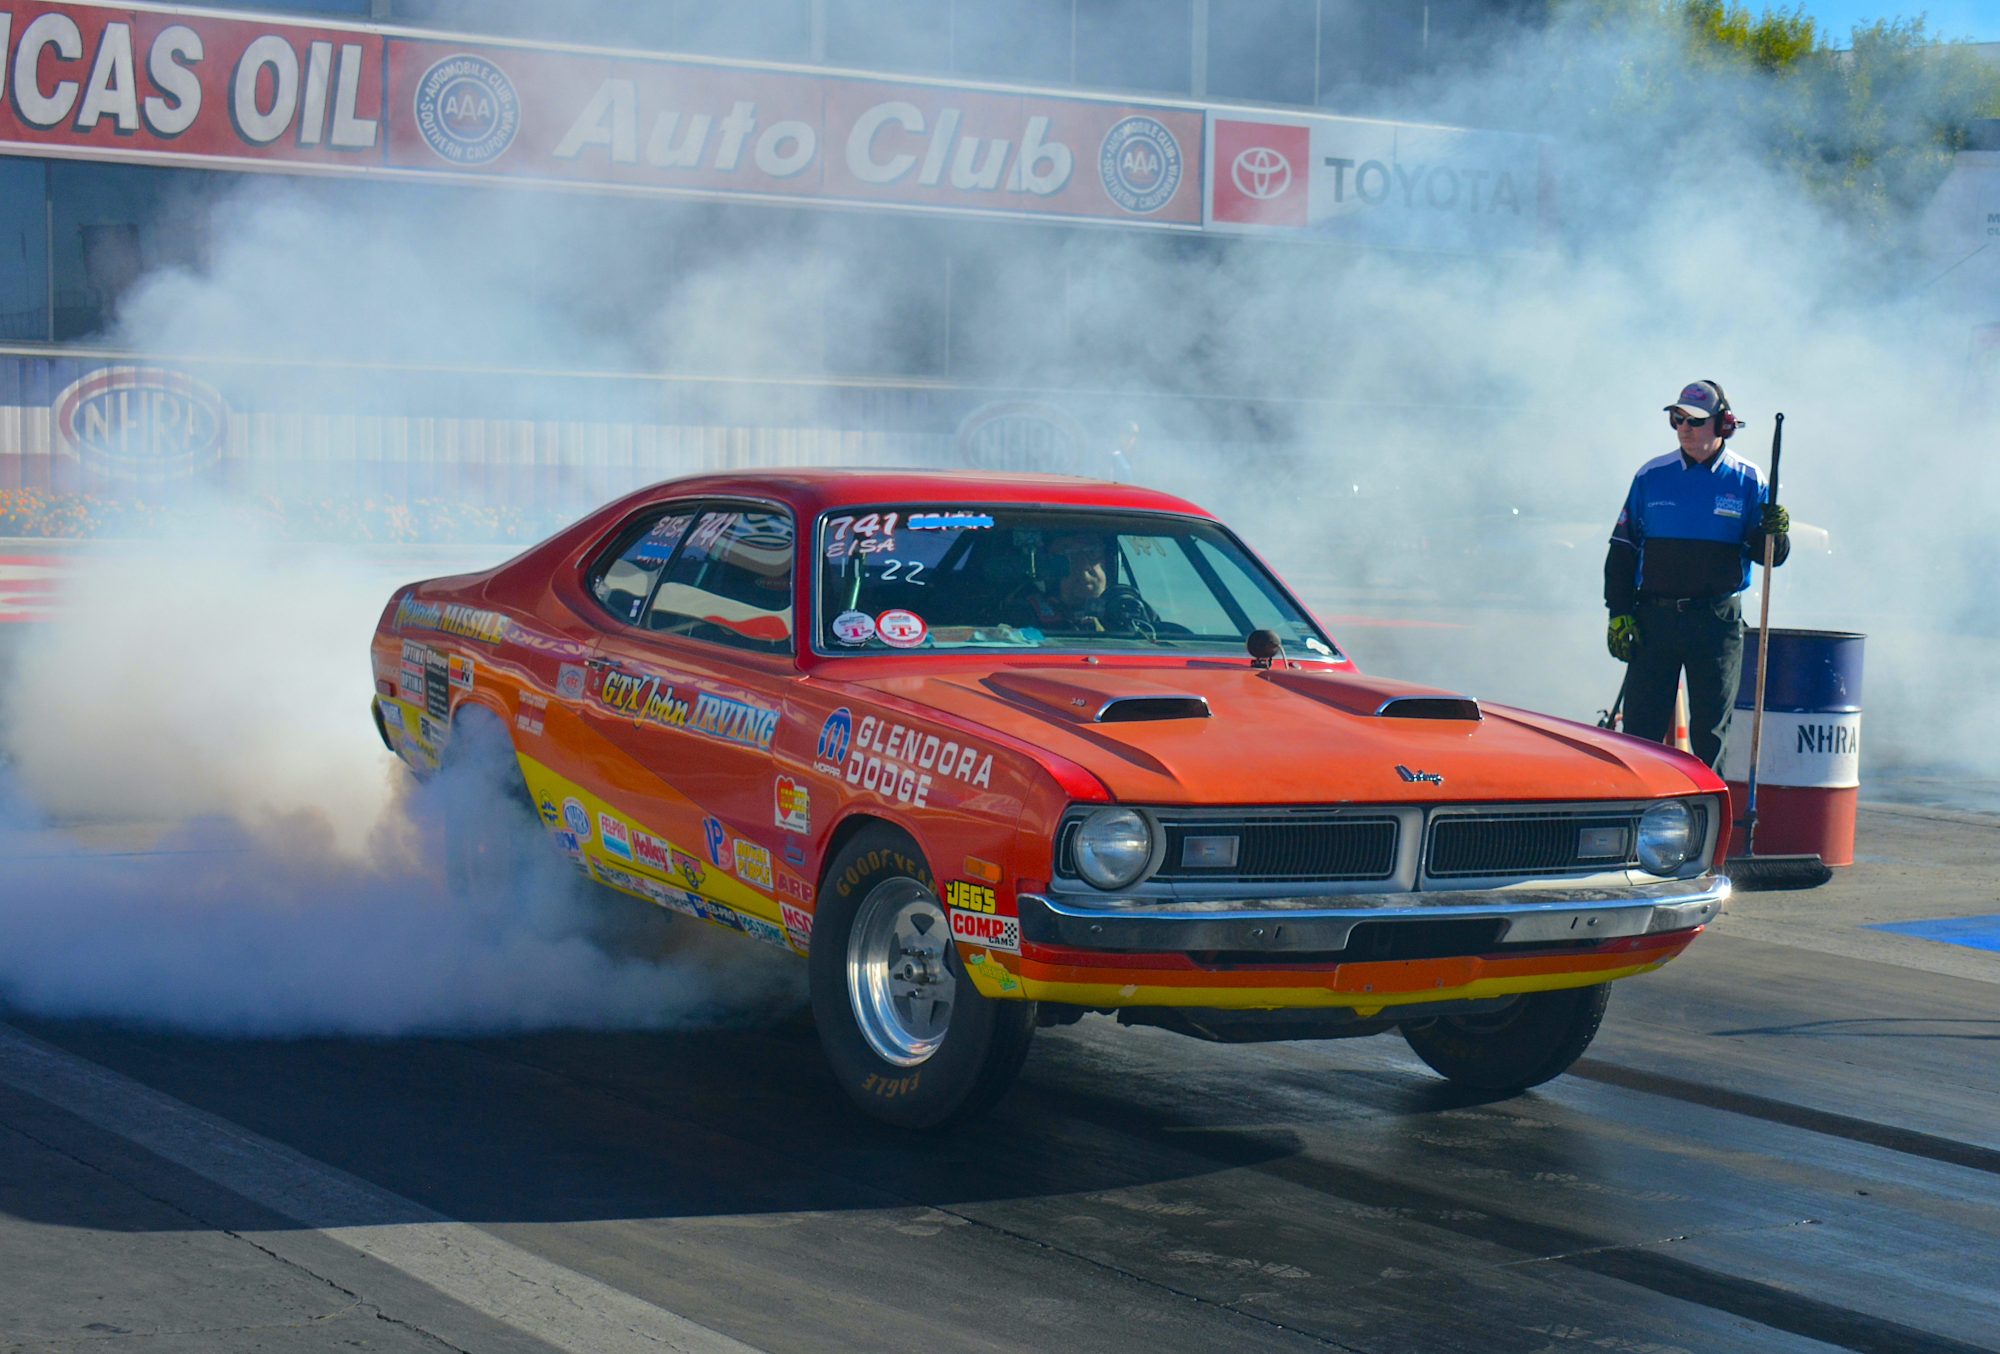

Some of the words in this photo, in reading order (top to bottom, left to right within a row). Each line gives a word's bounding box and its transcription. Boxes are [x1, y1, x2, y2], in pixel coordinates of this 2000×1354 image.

[232, 34, 379, 149] OIL
[425, 61, 490, 99] AUTOMOBILE
[488, 73, 513, 104] CLUB
[444, 93, 491, 121] AAA
[419, 101, 463, 159] SOUTHERN
[552, 77, 817, 179] Auto
[845, 99, 1074, 196] Club
[1122, 150, 1159, 175] AAA
[1323, 157, 1521, 216] TOYOTA
[685, 511, 741, 549] 741
[829, 512, 899, 542] 741
[825, 537, 896, 558] E/SA
[440, 603, 512, 646] MISSILE
[601, 670, 650, 716] GTX
[633, 675, 691, 730] John
[687, 691, 782, 751] IRVING
[856, 715, 994, 790] GLENDORA
[1796, 724, 1857, 754] NHRA
[812, 761, 842, 780] MOPAR
[846, 751, 933, 809] DODGE
[632, 830, 669, 873] Holley
[777, 871, 815, 905] ARP
[953, 913, 1004, 938] COMP
[988, 935, 1015, 947] CAMS
